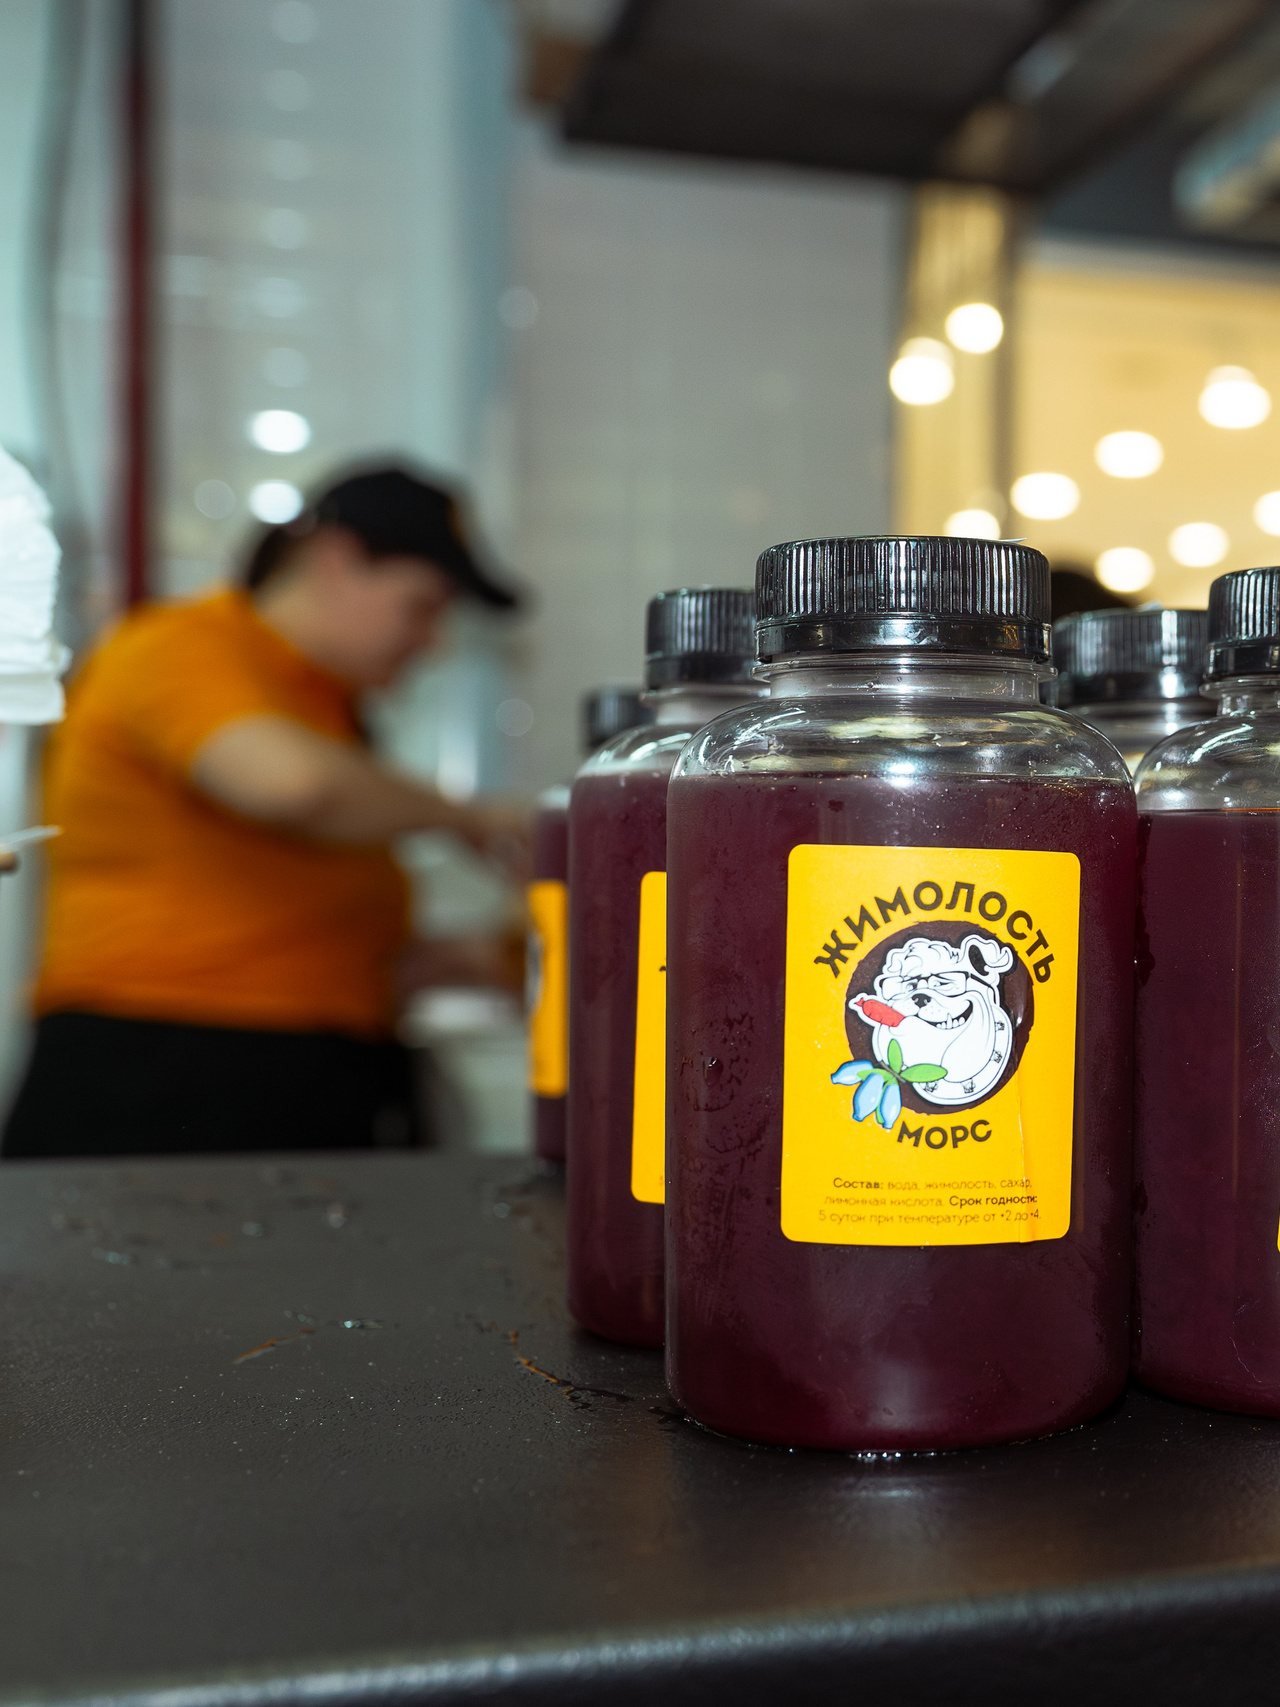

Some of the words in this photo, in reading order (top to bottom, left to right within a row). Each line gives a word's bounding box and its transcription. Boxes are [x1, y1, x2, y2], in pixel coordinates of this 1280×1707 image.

[814, 881, 1055, 983] ЖИМОЛОСТЬ
[897, 1119, 992, 1149] МОРС
[833, 1177, 884, 1190] Состав:
[824, 1195, 887, 1207] лимонная
[949, 1195, 982, 1209] Срок
[986, 1193, 1038, 1206] годности:
[818, 1210, 827, 1222] 5
[830, 1212, 867, 1225] суток
[869, 1213, 894, 1225] при
[899, 1213, 980, 1226] температуре
[983, 1213, 996, 1222] от
[1014, 1212, 1029, 1222] до
